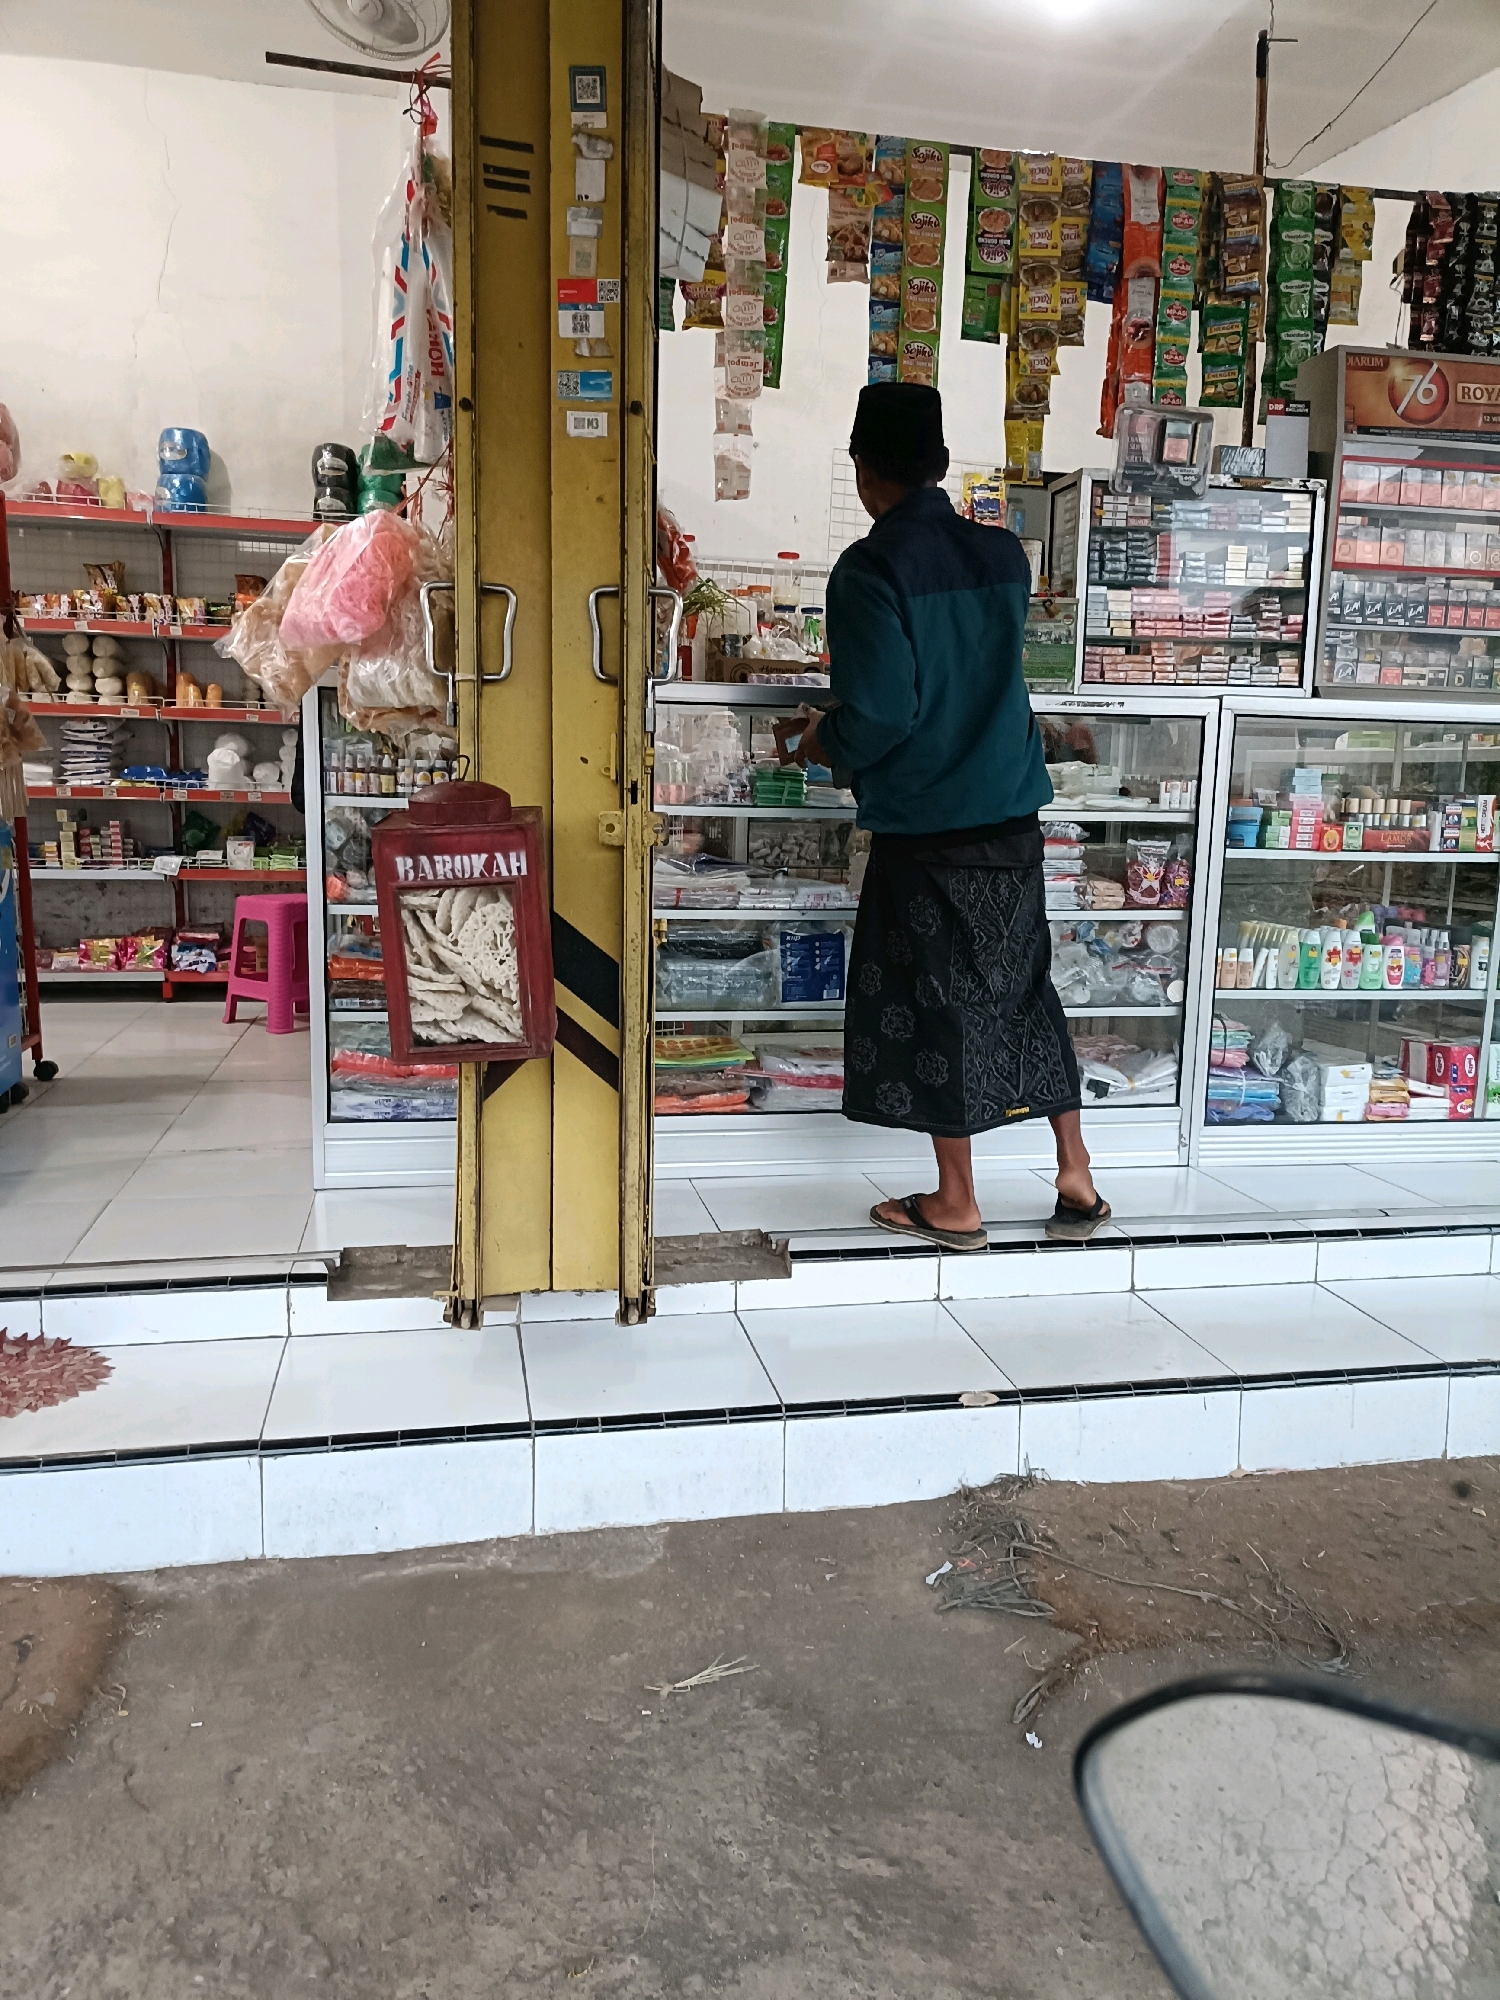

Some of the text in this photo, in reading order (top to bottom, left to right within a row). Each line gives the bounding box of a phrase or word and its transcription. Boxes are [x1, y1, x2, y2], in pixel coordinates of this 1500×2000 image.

[1029, 166, 1053, 179] Racik
[1061, 163, 1085, 176] Racik
[1029, 230, 1053, 242] Racik
[1028, 294, 1053, 306] Racik
[1060, 293, 1079, 304] acik
[1209, 323, 1240, 333] ENERGEN
[1028, 356, 1052, 369] Racik
[1206, 371, 1237, 380] ENERGEN
[1396, 360, 1439, 417] 76
[1268, 403, 1284, 411] DRP
[587, 417, 599, 430] M3
[395, 851, 528, 882] BAROKAH
